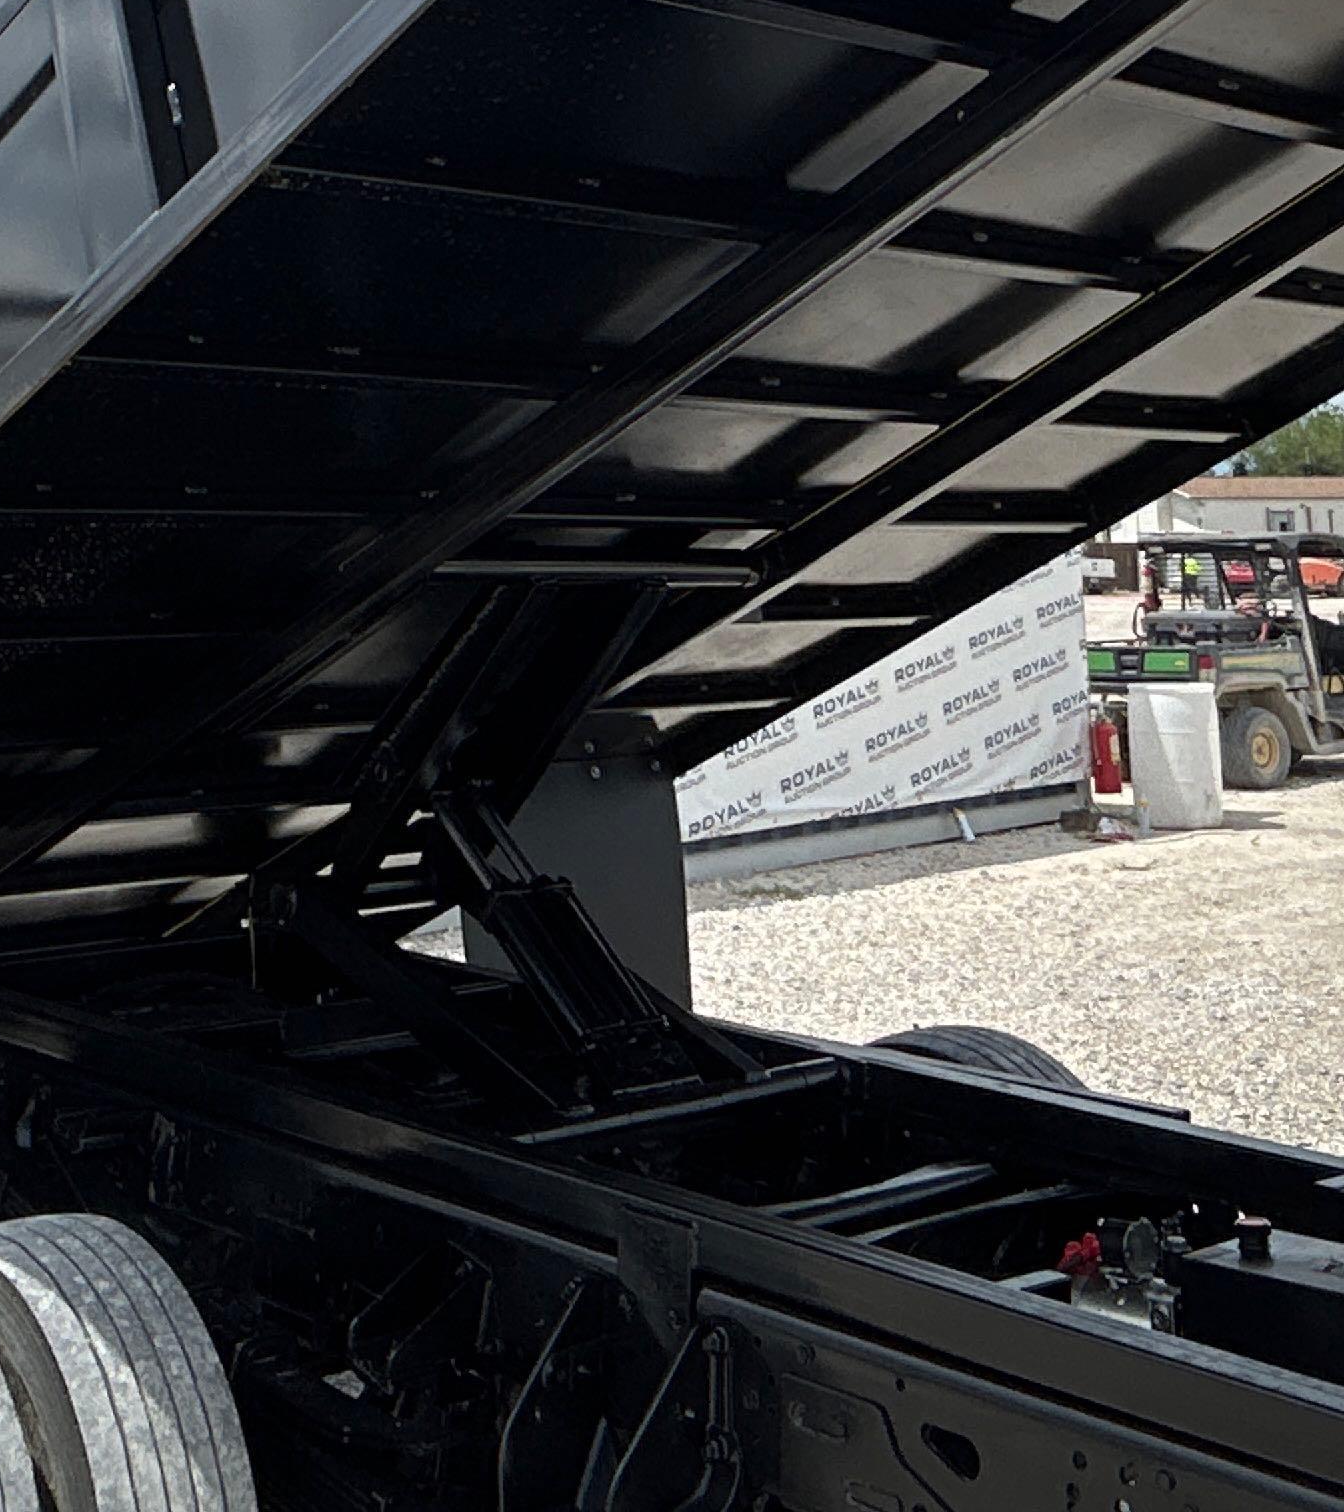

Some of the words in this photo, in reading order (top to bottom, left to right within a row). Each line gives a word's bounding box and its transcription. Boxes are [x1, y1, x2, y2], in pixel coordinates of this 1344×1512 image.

[1037, 593, 1079, 619] ROYAL
[969, 622, 1013, 649] ROYAL
[895, 652, 943, 683] ROYAL
[1013, 654, 1057, 682] ROYAL
[813, 686, 866, 719] ROYAL
[942, 686, 989, 716] ROYAL
[1052, 690, 1087, 716] ROYA
[865, 720, 916, 752] ROYAL
[984, 718, 1029, 749] ROYAL
[780, 758, 836, 793] ROYAL
[910, 754, 959, 787] ROYAL
[1031, 750, 1074, 780] ROYAL
[688, 800, 749, 838] ROYAL
